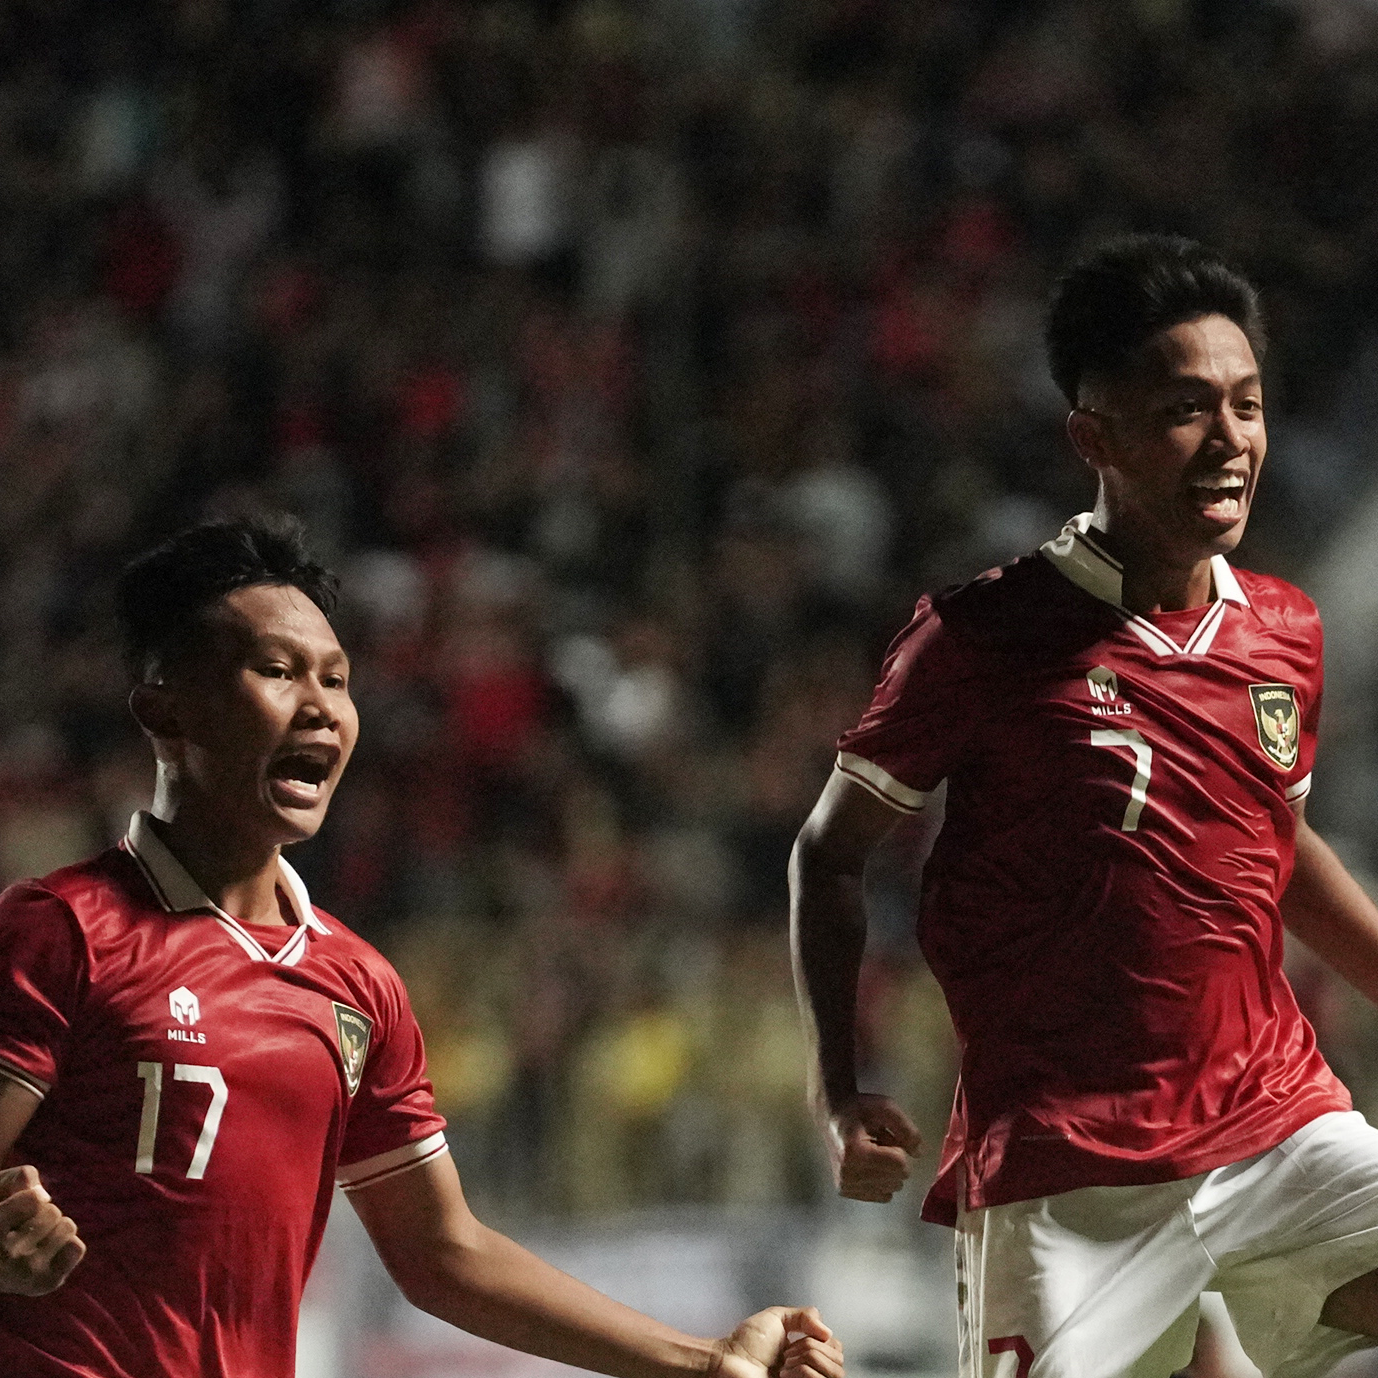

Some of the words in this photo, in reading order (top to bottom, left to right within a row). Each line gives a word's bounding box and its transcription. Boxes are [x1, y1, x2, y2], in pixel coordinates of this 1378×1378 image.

[1091, 703, 1132, 716] MILLS
[1090, 728, 1153, 832] 7
[167, 1028, 206, 1045] MILLS
[135, 1061, 229, 1180] 17
